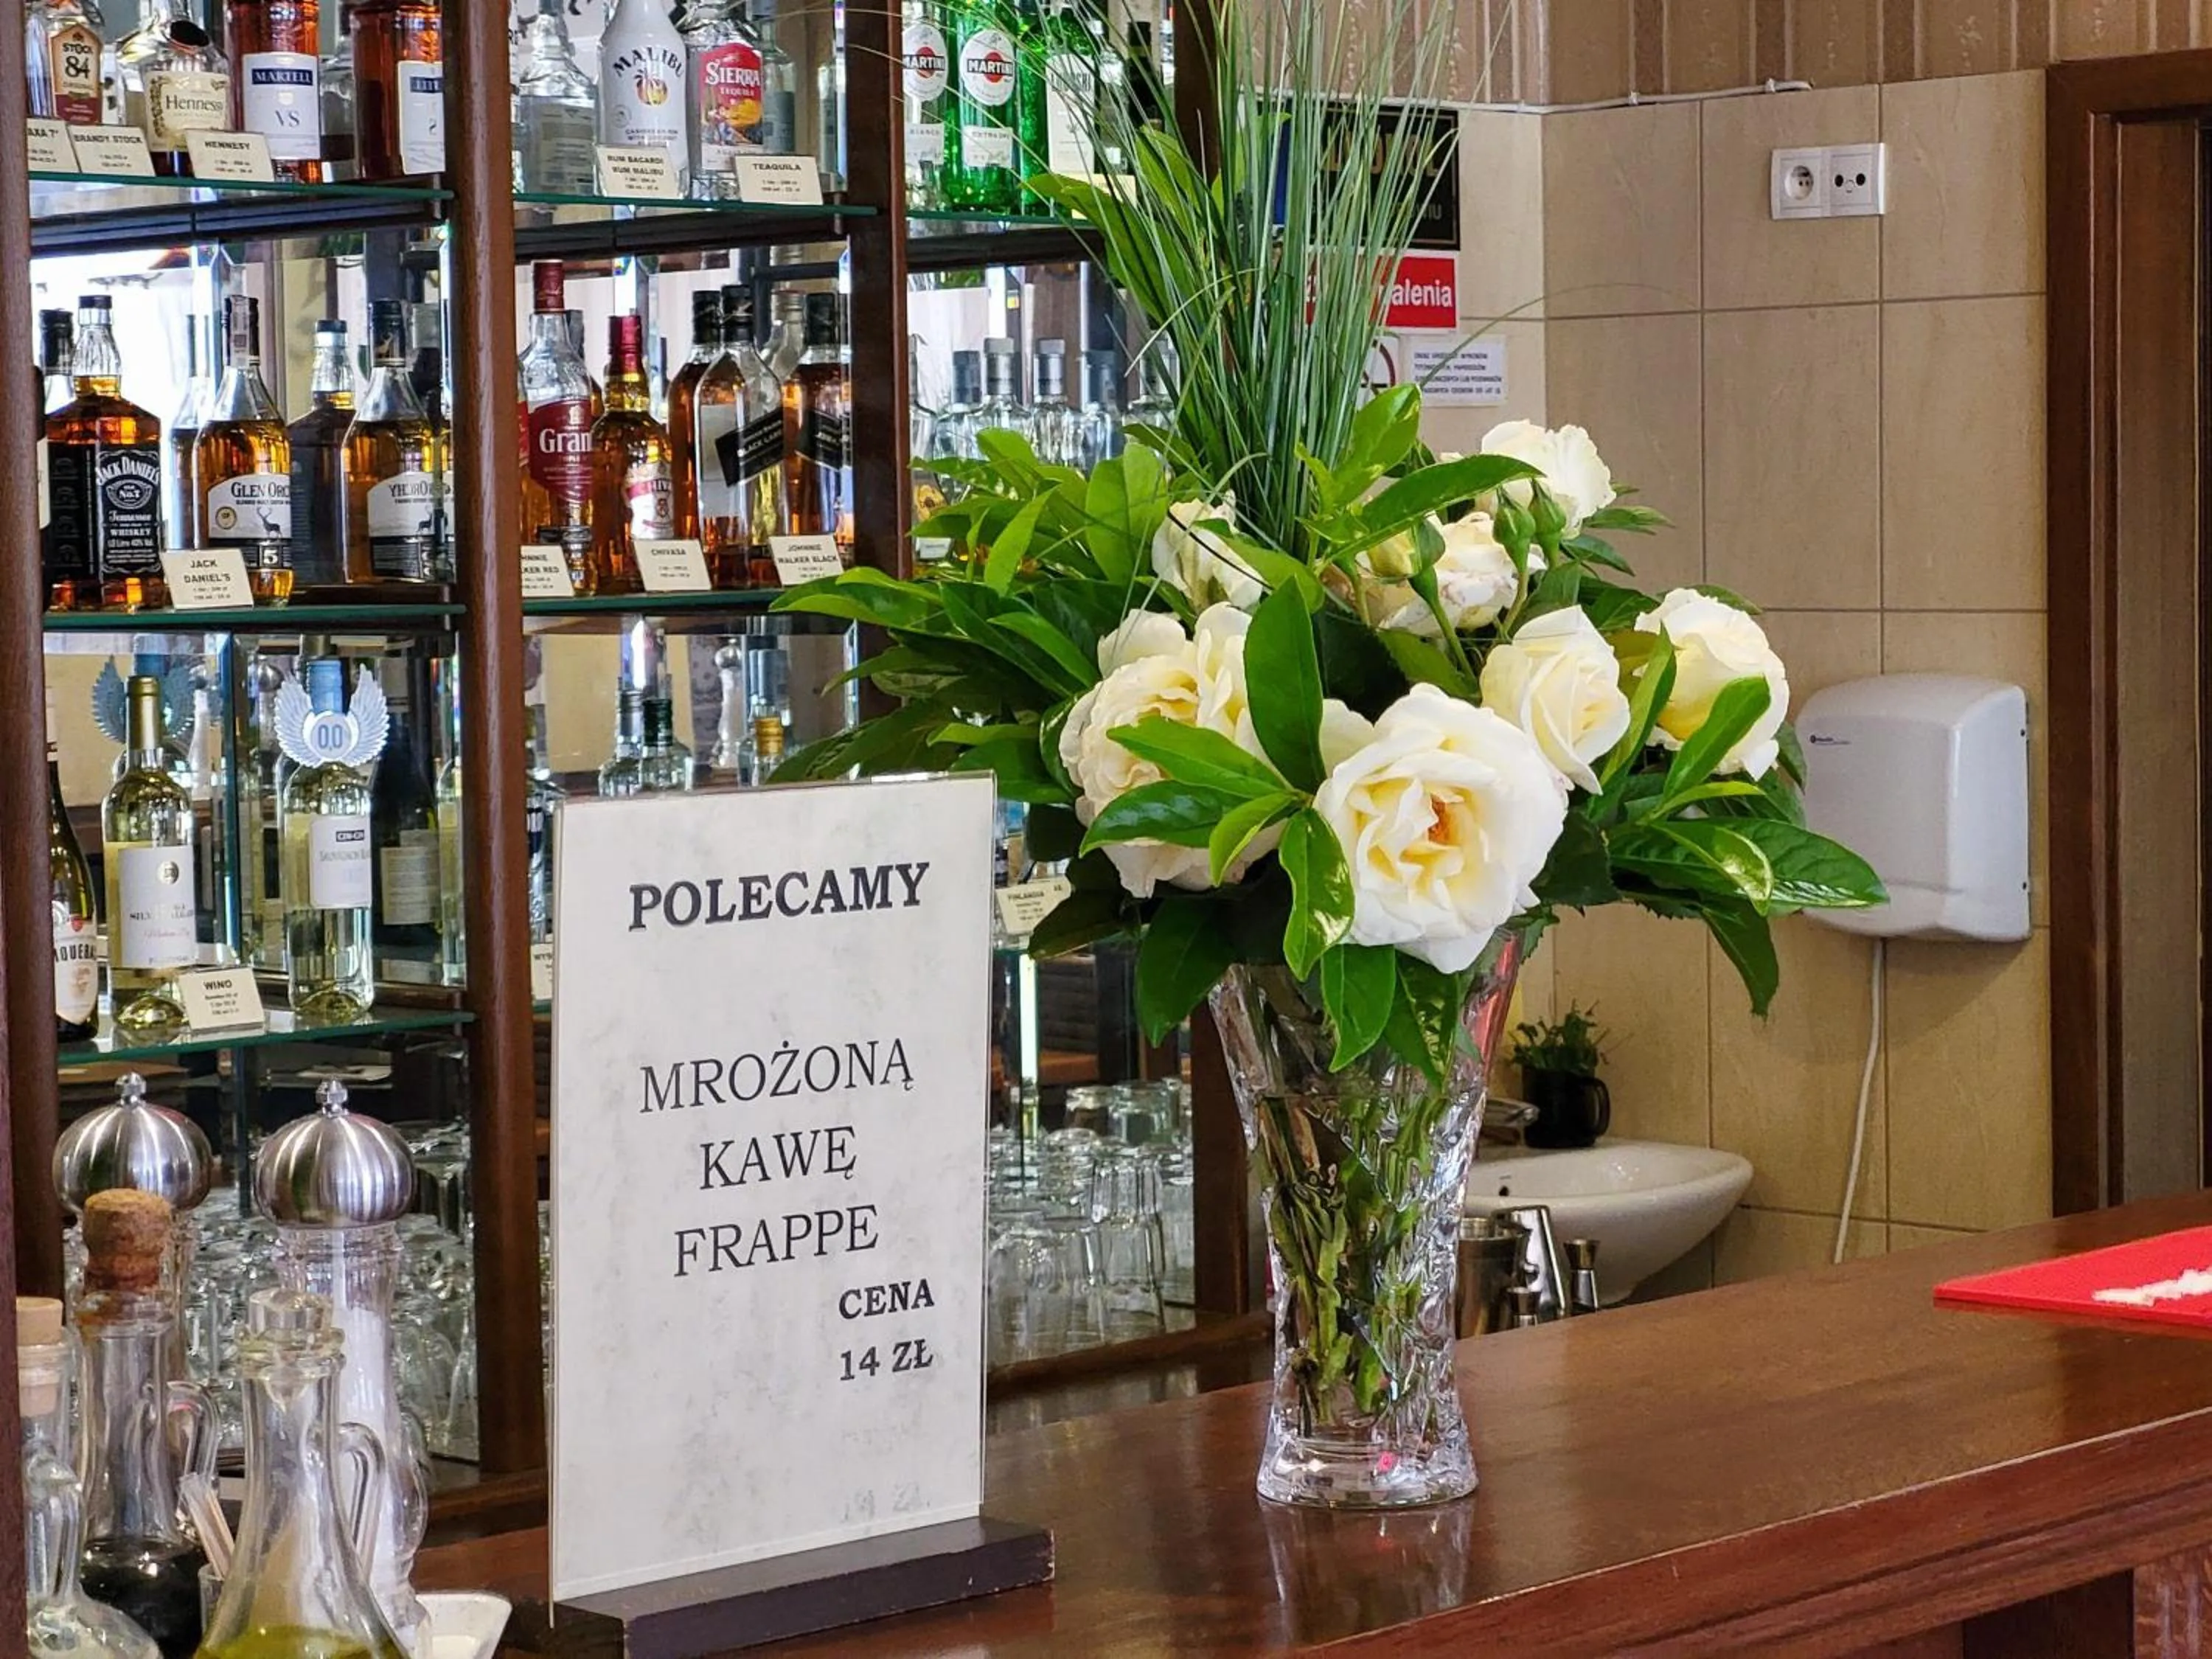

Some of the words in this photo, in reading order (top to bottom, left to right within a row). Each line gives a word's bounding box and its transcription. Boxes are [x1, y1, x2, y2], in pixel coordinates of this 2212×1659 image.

[62, 43, 94, 54] STOCK
[65, 55, 91, 79] 84
[613, 46, 684, 77] MALIBU
[253, 70, 311, 83] MARTELL
[706, 59, 761, 88] SIERRA
[274, 110, 301, 128] VS
[74, 134, 110, 143] BRANDY
[112, 135, 143, 144] STOCK
[612, 165, 630, 173] RUM
[752, 163, 801, 171] TEAQUILA
[539, 428, 593, 453] Gran
[95, 461, 122, 486] JACK
[231, 481, 265, 498] GLEN
[190, 559, 218, 568] JACK
[263, 549, 278, 565] 5
[184, 573, 231, 583] DANIEL'S
[627, 861, 930, 931] POLECAMY
[204, 979, 232, 990] WINO
[639, 1037, 914, 1114] MROŻONĄ
[700, 1126, 858, 1189] KAWĘ
[674, 1204, 880, 1277] FRAPPE
[838, 1279, 935, 1319] CENA
[840, 1346, 880, 1381] 14
[892, 1338, 933, 1372] ZŁ
